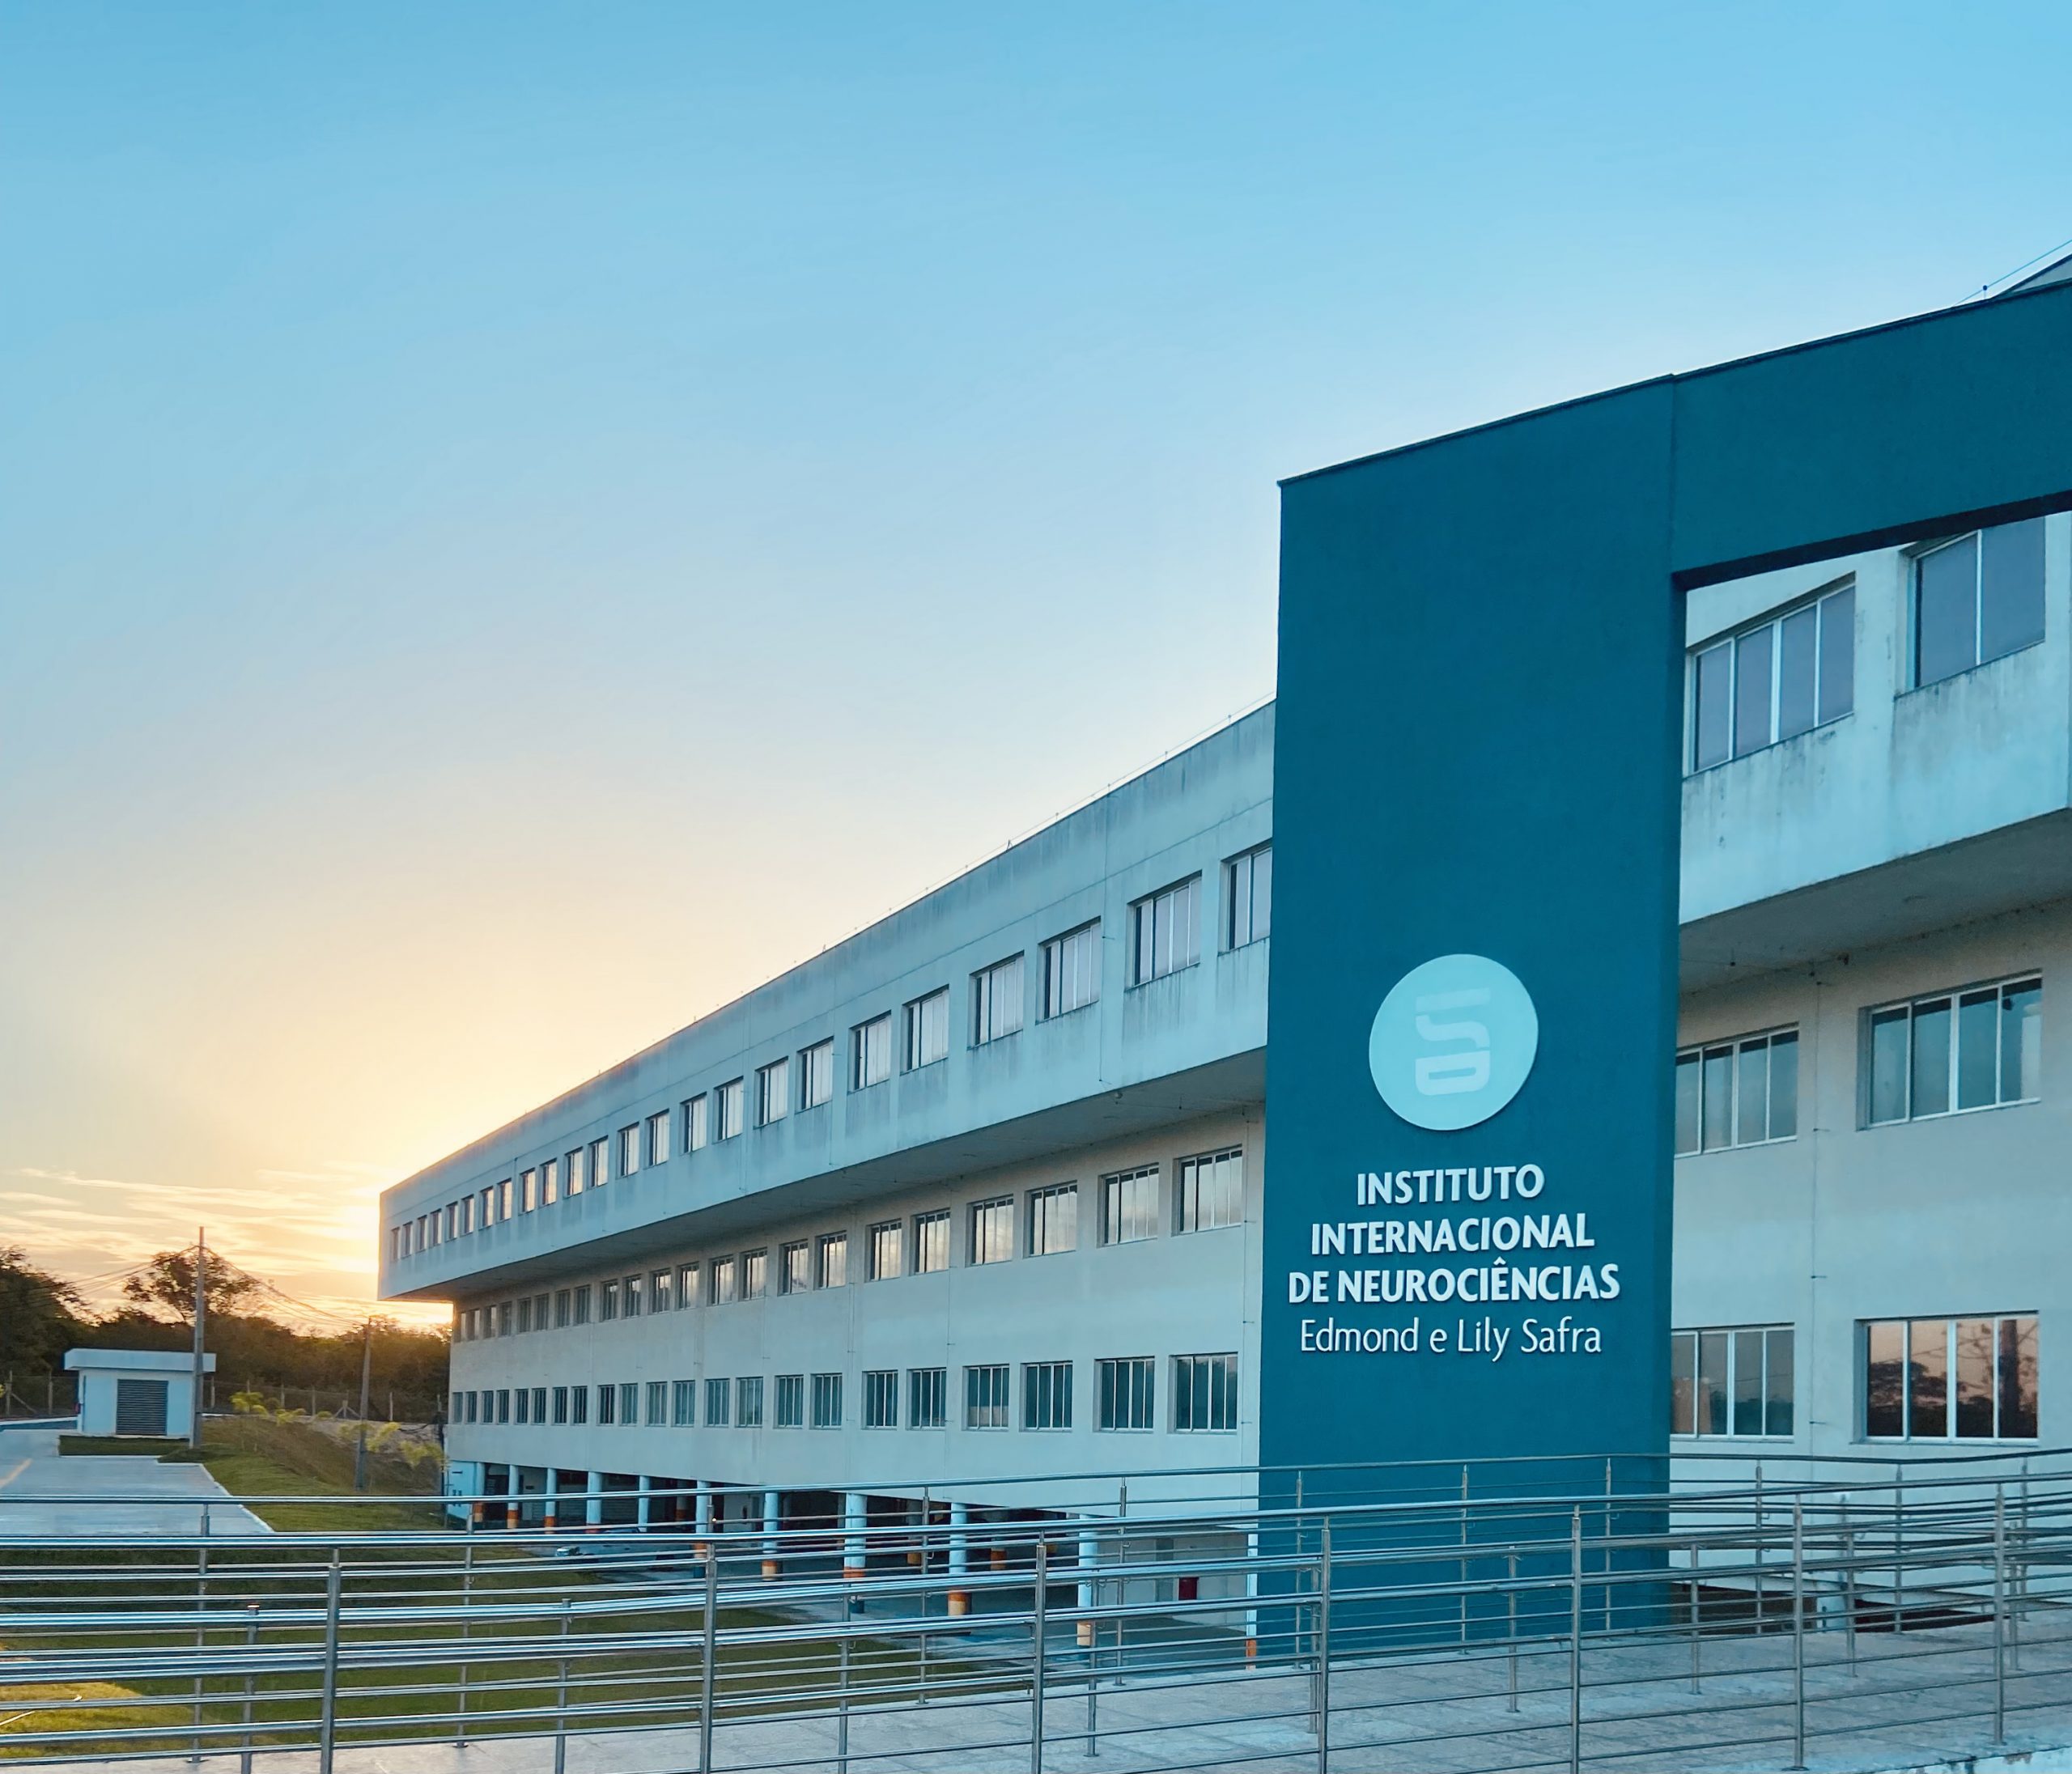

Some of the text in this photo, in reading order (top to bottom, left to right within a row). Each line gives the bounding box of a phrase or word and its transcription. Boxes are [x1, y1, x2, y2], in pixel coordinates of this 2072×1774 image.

[1357, 1165, 1544, 1205] INSTITUTO
[1311, 1213, 1594, 1255] INTERNACIONAL
[1289, 1257, 1620, 1303] DE NEUROCIÊNCIAS
[1301, 1317, 1602, 1362] Edmond e Lily Safra
